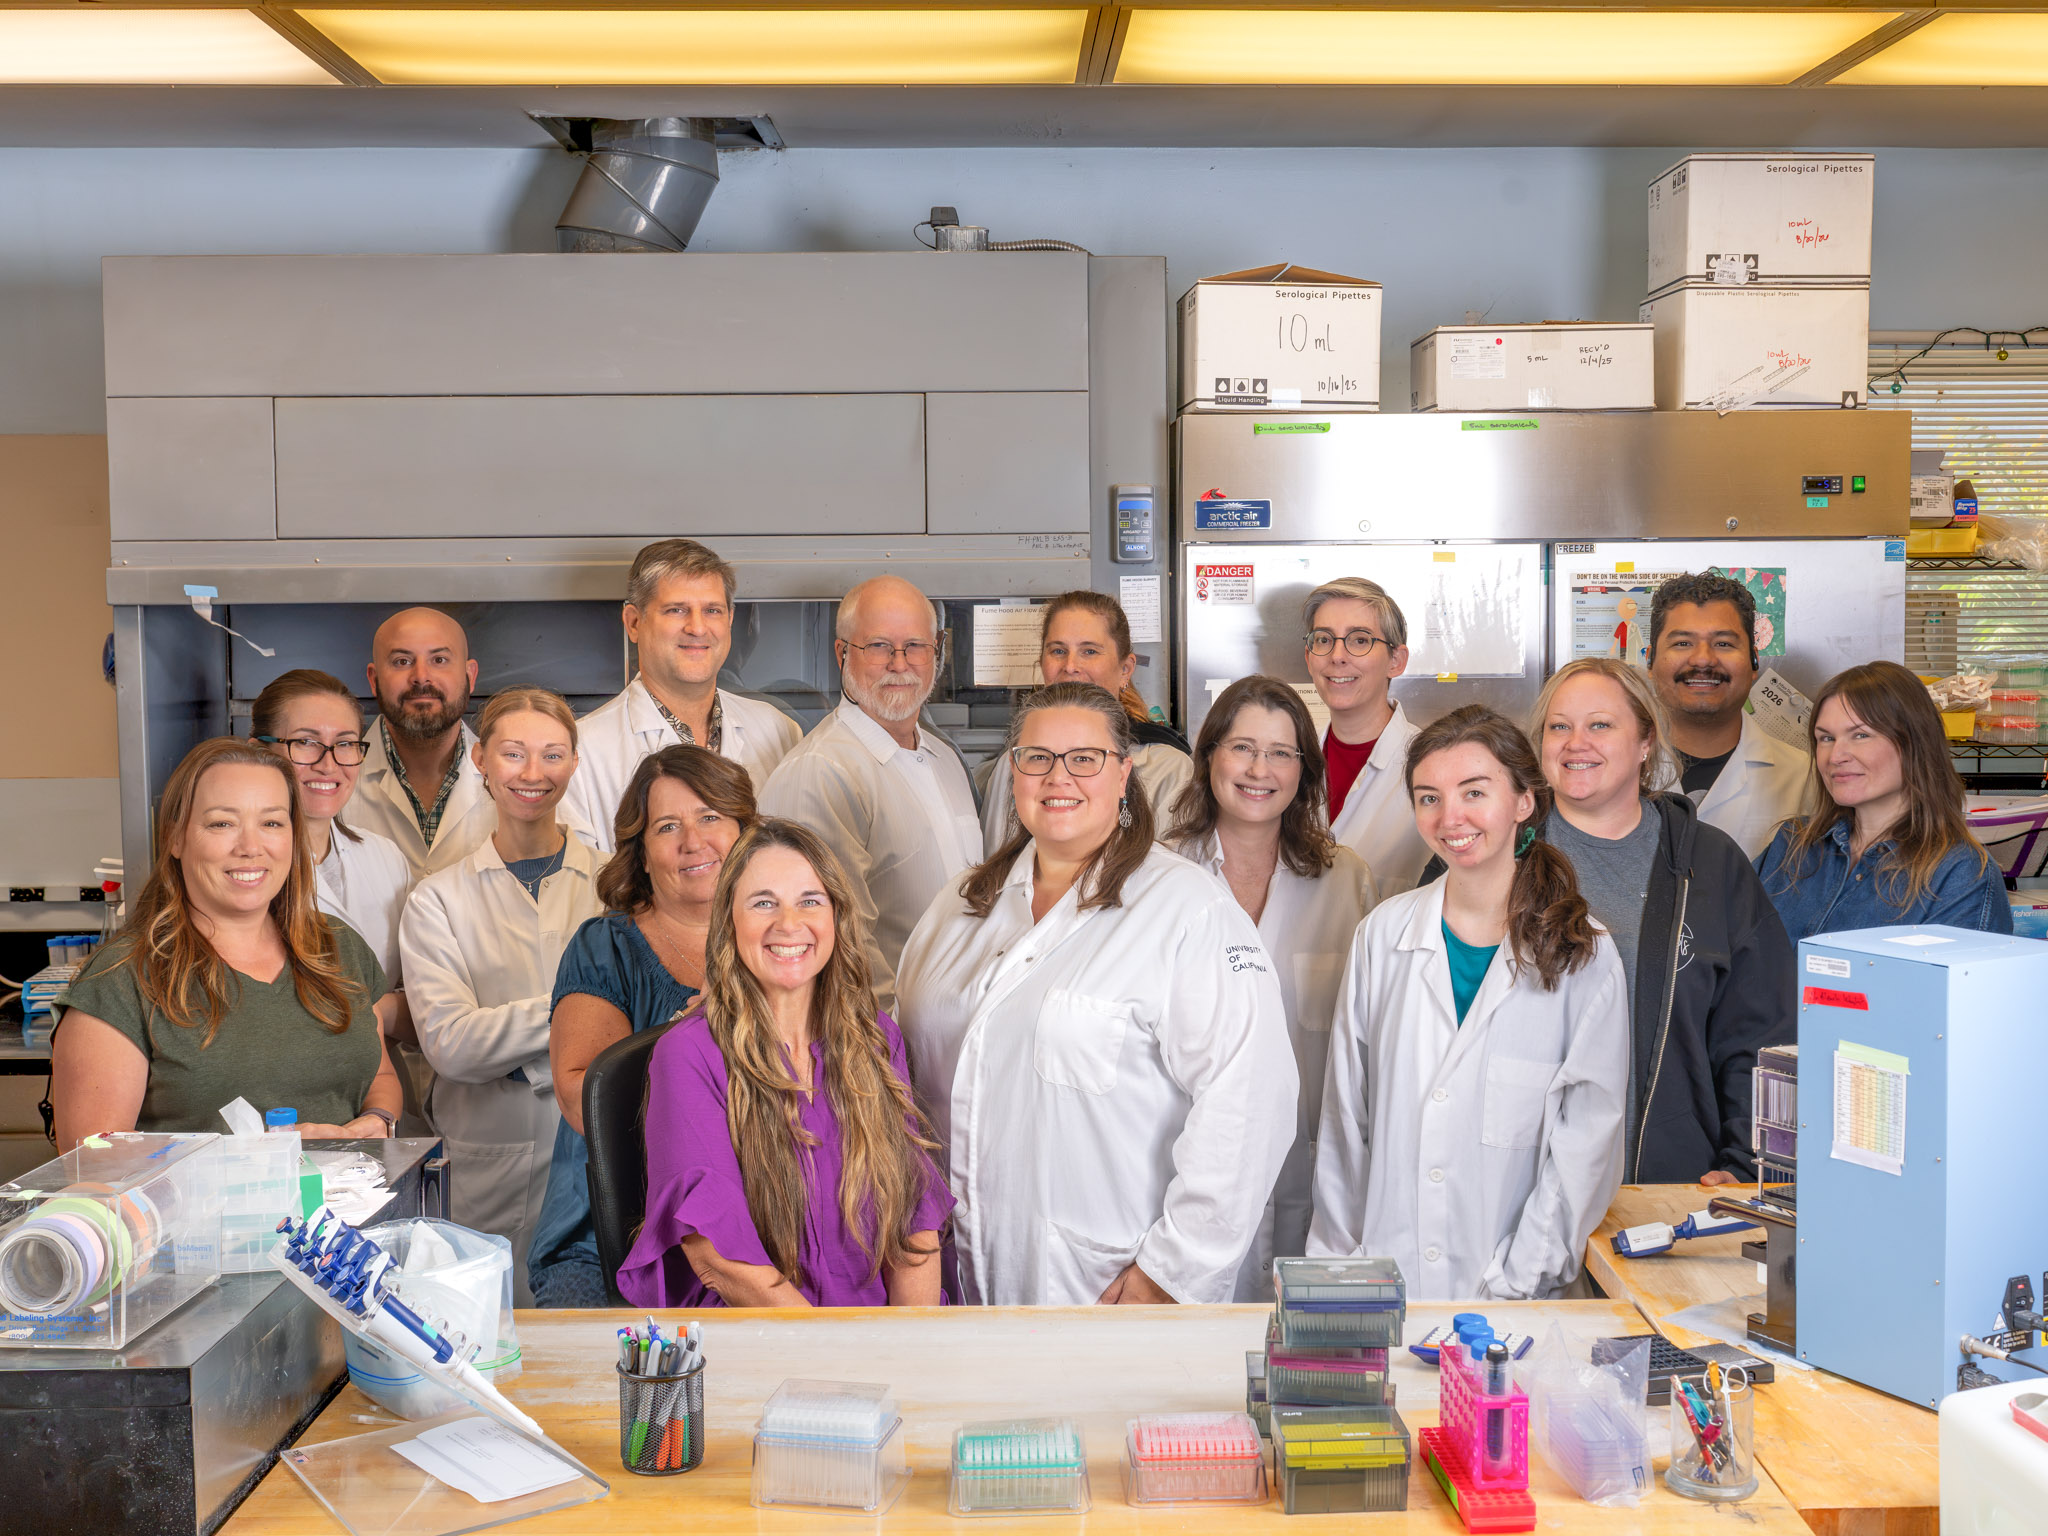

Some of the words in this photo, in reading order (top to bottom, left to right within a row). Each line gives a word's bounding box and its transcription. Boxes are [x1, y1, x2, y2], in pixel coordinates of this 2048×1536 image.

[1766, 165, 1819, 175] Serological
[1824, 165, 1863, 175] Pipettes
[1275, 290, 1328, 300] Serological
[1332, 291, 1371, 301] Pipettes
[1318, 374, 1357, 395] 10/16/25
[1217, 396, 1237, 404] Liquid
[1238, 396, 1265, 404] Handling
[1209, 511, 1241, 520] arctic
[1243, 511, 1258, 520] air
[1557, 544, 1595, 553] FREEZER
[1206, 566, 1252, 576] DANGER
[1761, 686, 1784, 706] 2026
[1225, 945, 1261, 954] UNIVERSITY
[1228, 954, 1241, 963] OF
[1232, 961, 1267, 972] CALIFNIA
[9, 1314, 45, 1323] Labeling
[47, 1314, 86, 1323] Systems,
[89, 1314, 105, 1322] Inc.
